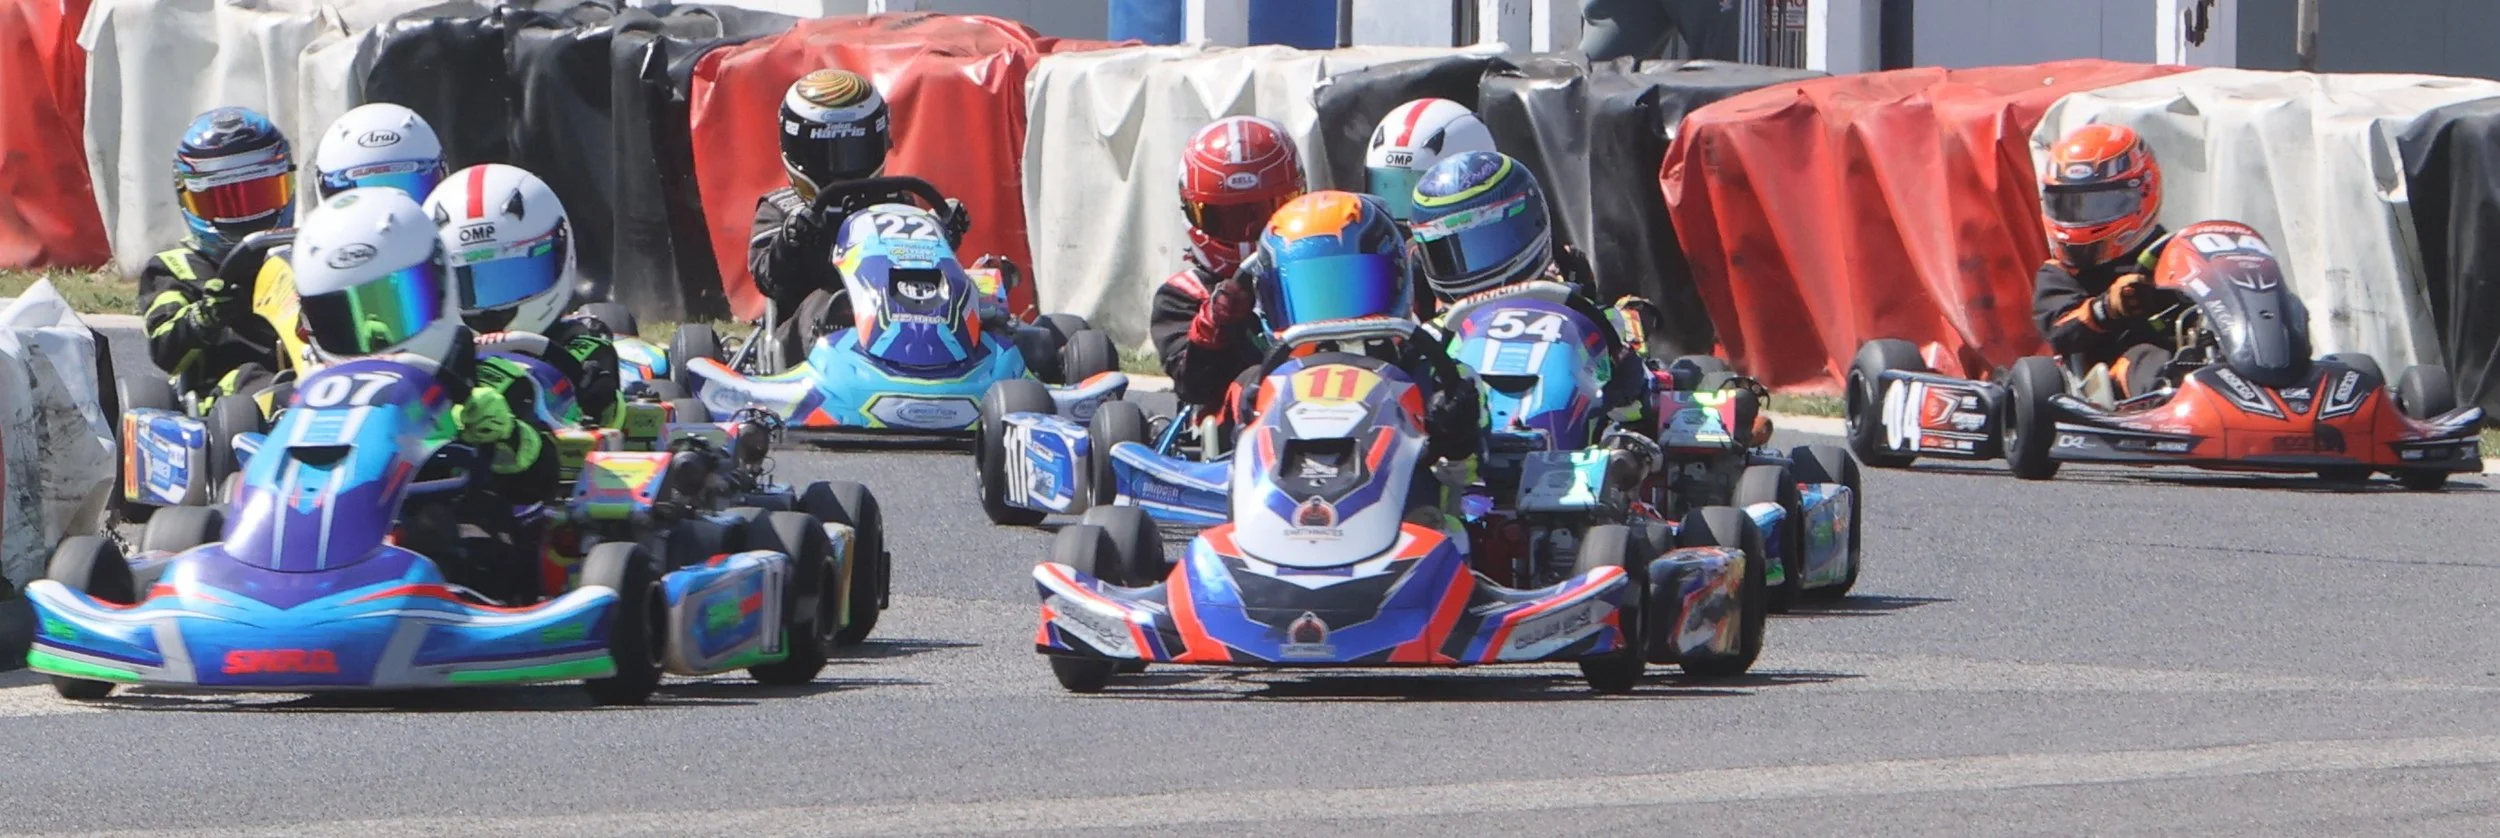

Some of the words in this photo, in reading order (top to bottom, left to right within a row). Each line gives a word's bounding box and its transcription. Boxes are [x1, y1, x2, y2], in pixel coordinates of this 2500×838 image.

[365, 131, 395, 143] Arai
[810, 127, 866, 139] Harris
[1385, 154, 1413, 164] OMP
[1231, 176, 1254, 185] BELL
[459, 225, 497, 241] OMP
[874, 213, 941, 240] 22
[2191, 232, 2273, 257] 04
[1487, 310, 1563, 342] 54
[304, 372, 401, 408] 07
[1307, 367, 1361, 398] 11
